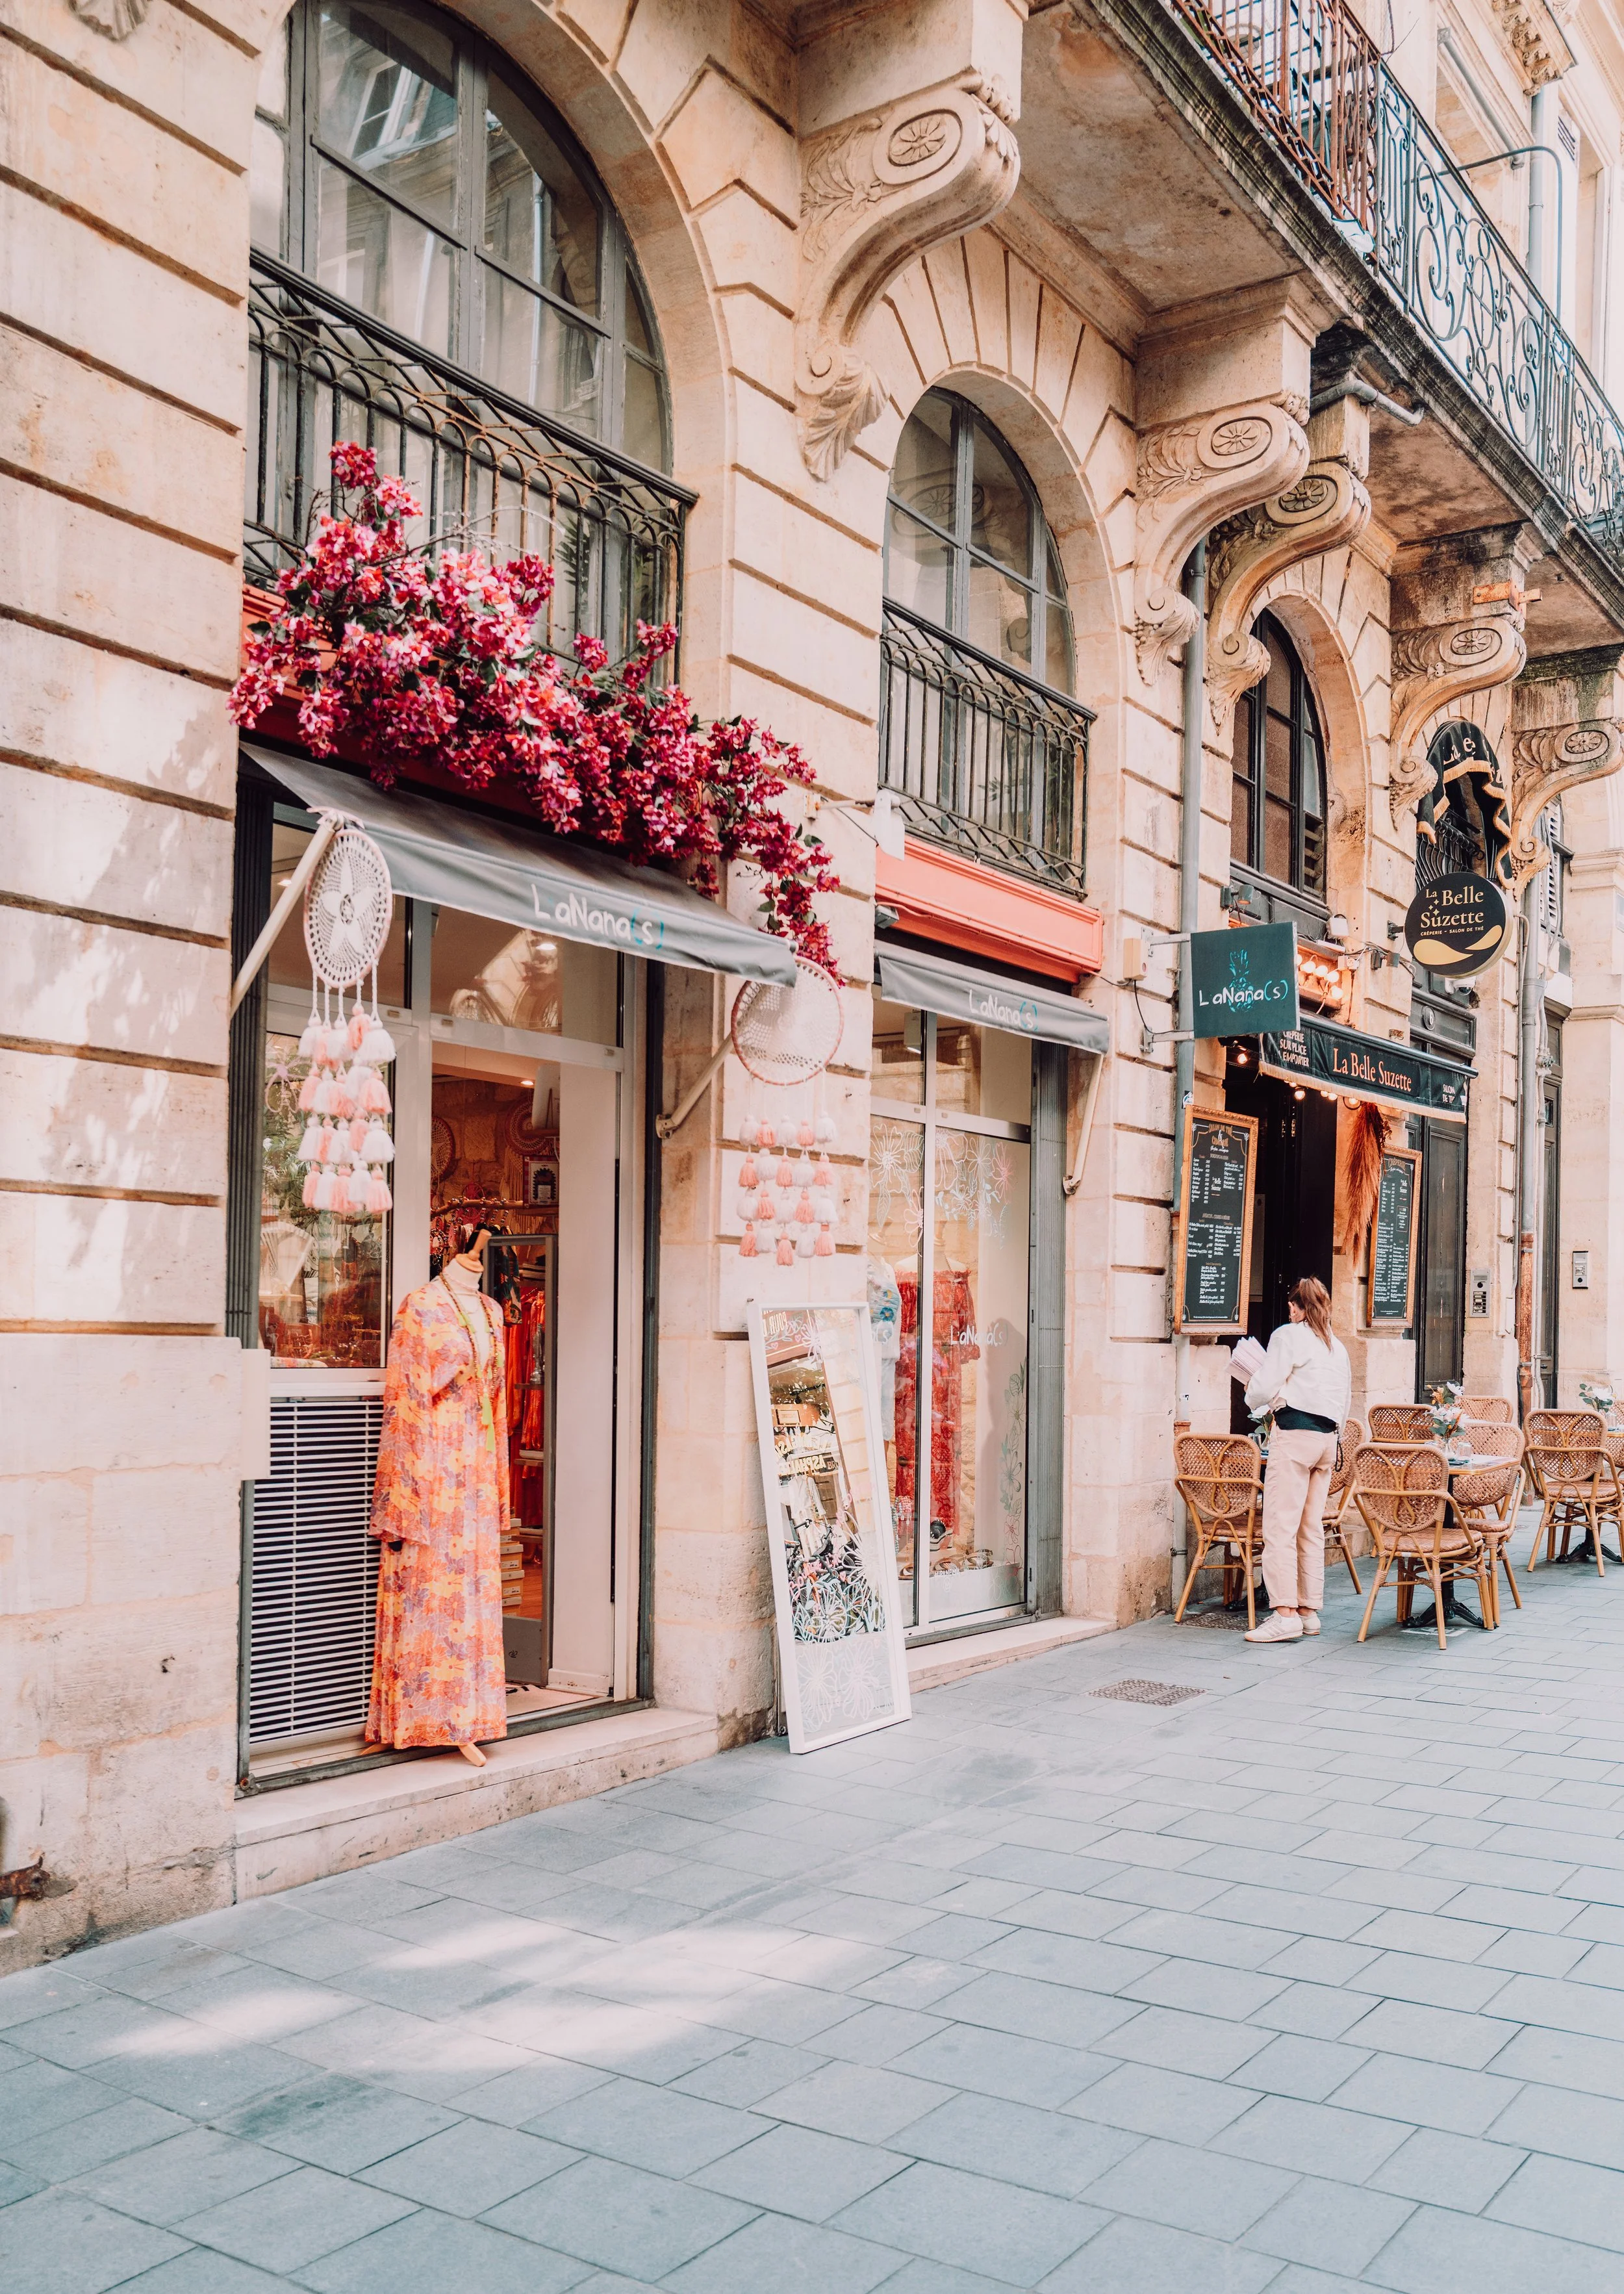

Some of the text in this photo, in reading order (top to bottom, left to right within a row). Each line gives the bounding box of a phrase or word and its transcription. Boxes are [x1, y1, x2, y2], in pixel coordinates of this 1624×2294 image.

[1426, 885, 1484, 906] La Belle
[1420, 911, 1484, 928] Suzette
[1280, 1039, 1291, 1051] SUR
[1333, 1048, 1412, 1092] La Belle Suzette
